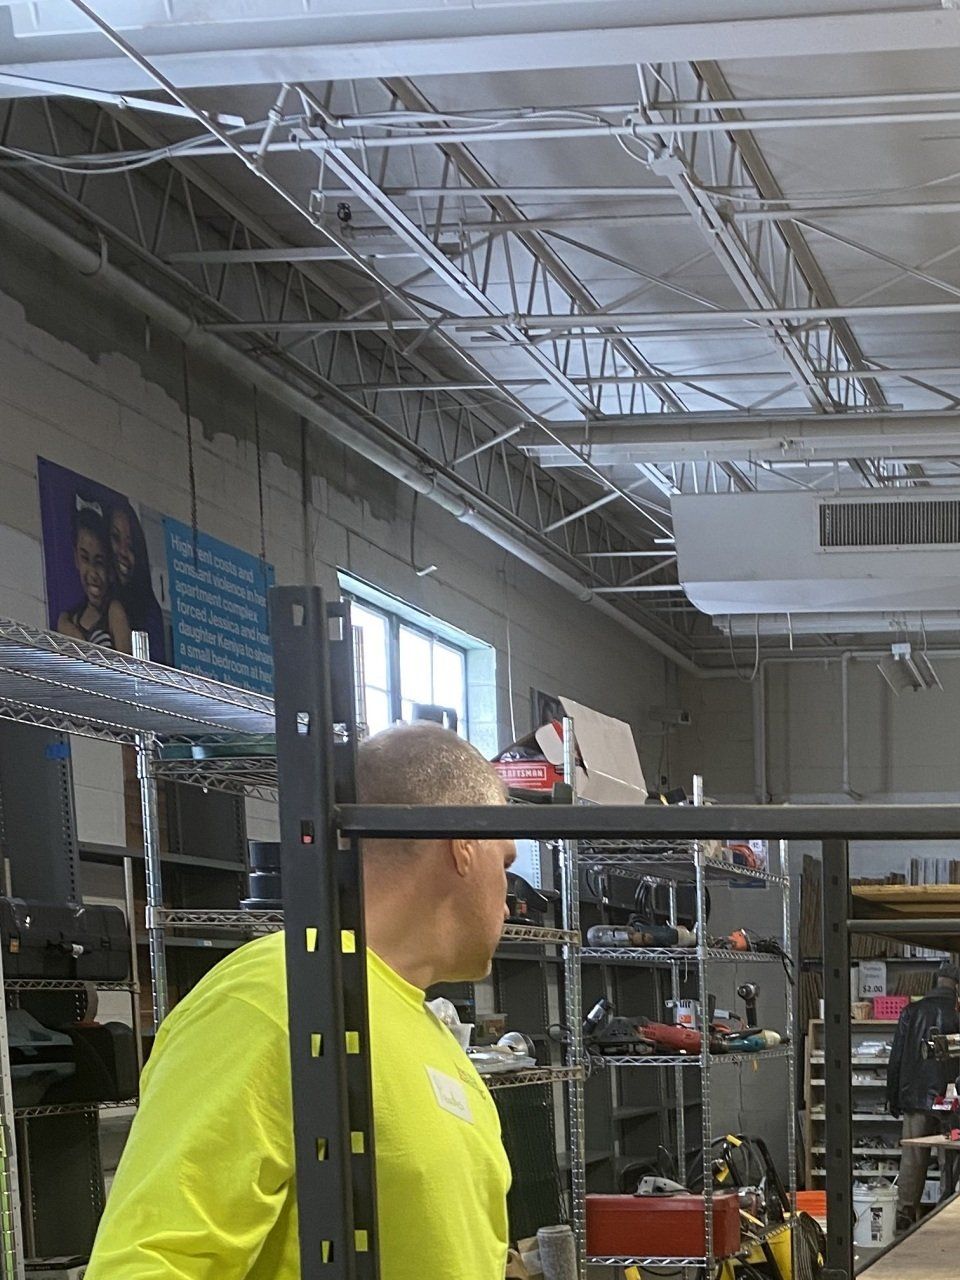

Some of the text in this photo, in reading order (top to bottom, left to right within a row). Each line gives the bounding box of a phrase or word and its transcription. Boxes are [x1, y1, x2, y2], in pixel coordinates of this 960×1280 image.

[170, 532, 254, 583] High ent costs and
[175, 579, 258, 623] apartment complex
[212, 572, 246, 599] violence
[177, 597, 207, 622] forced
[208, 610, 240, 634] Jessica
[241, 623, 256, 641] and
[178, 619, 217, 645] daughter
[180, 642, 187, 656] a
[187, 645, 212, 664] small
[212, 650, 249, 675] bedroom
